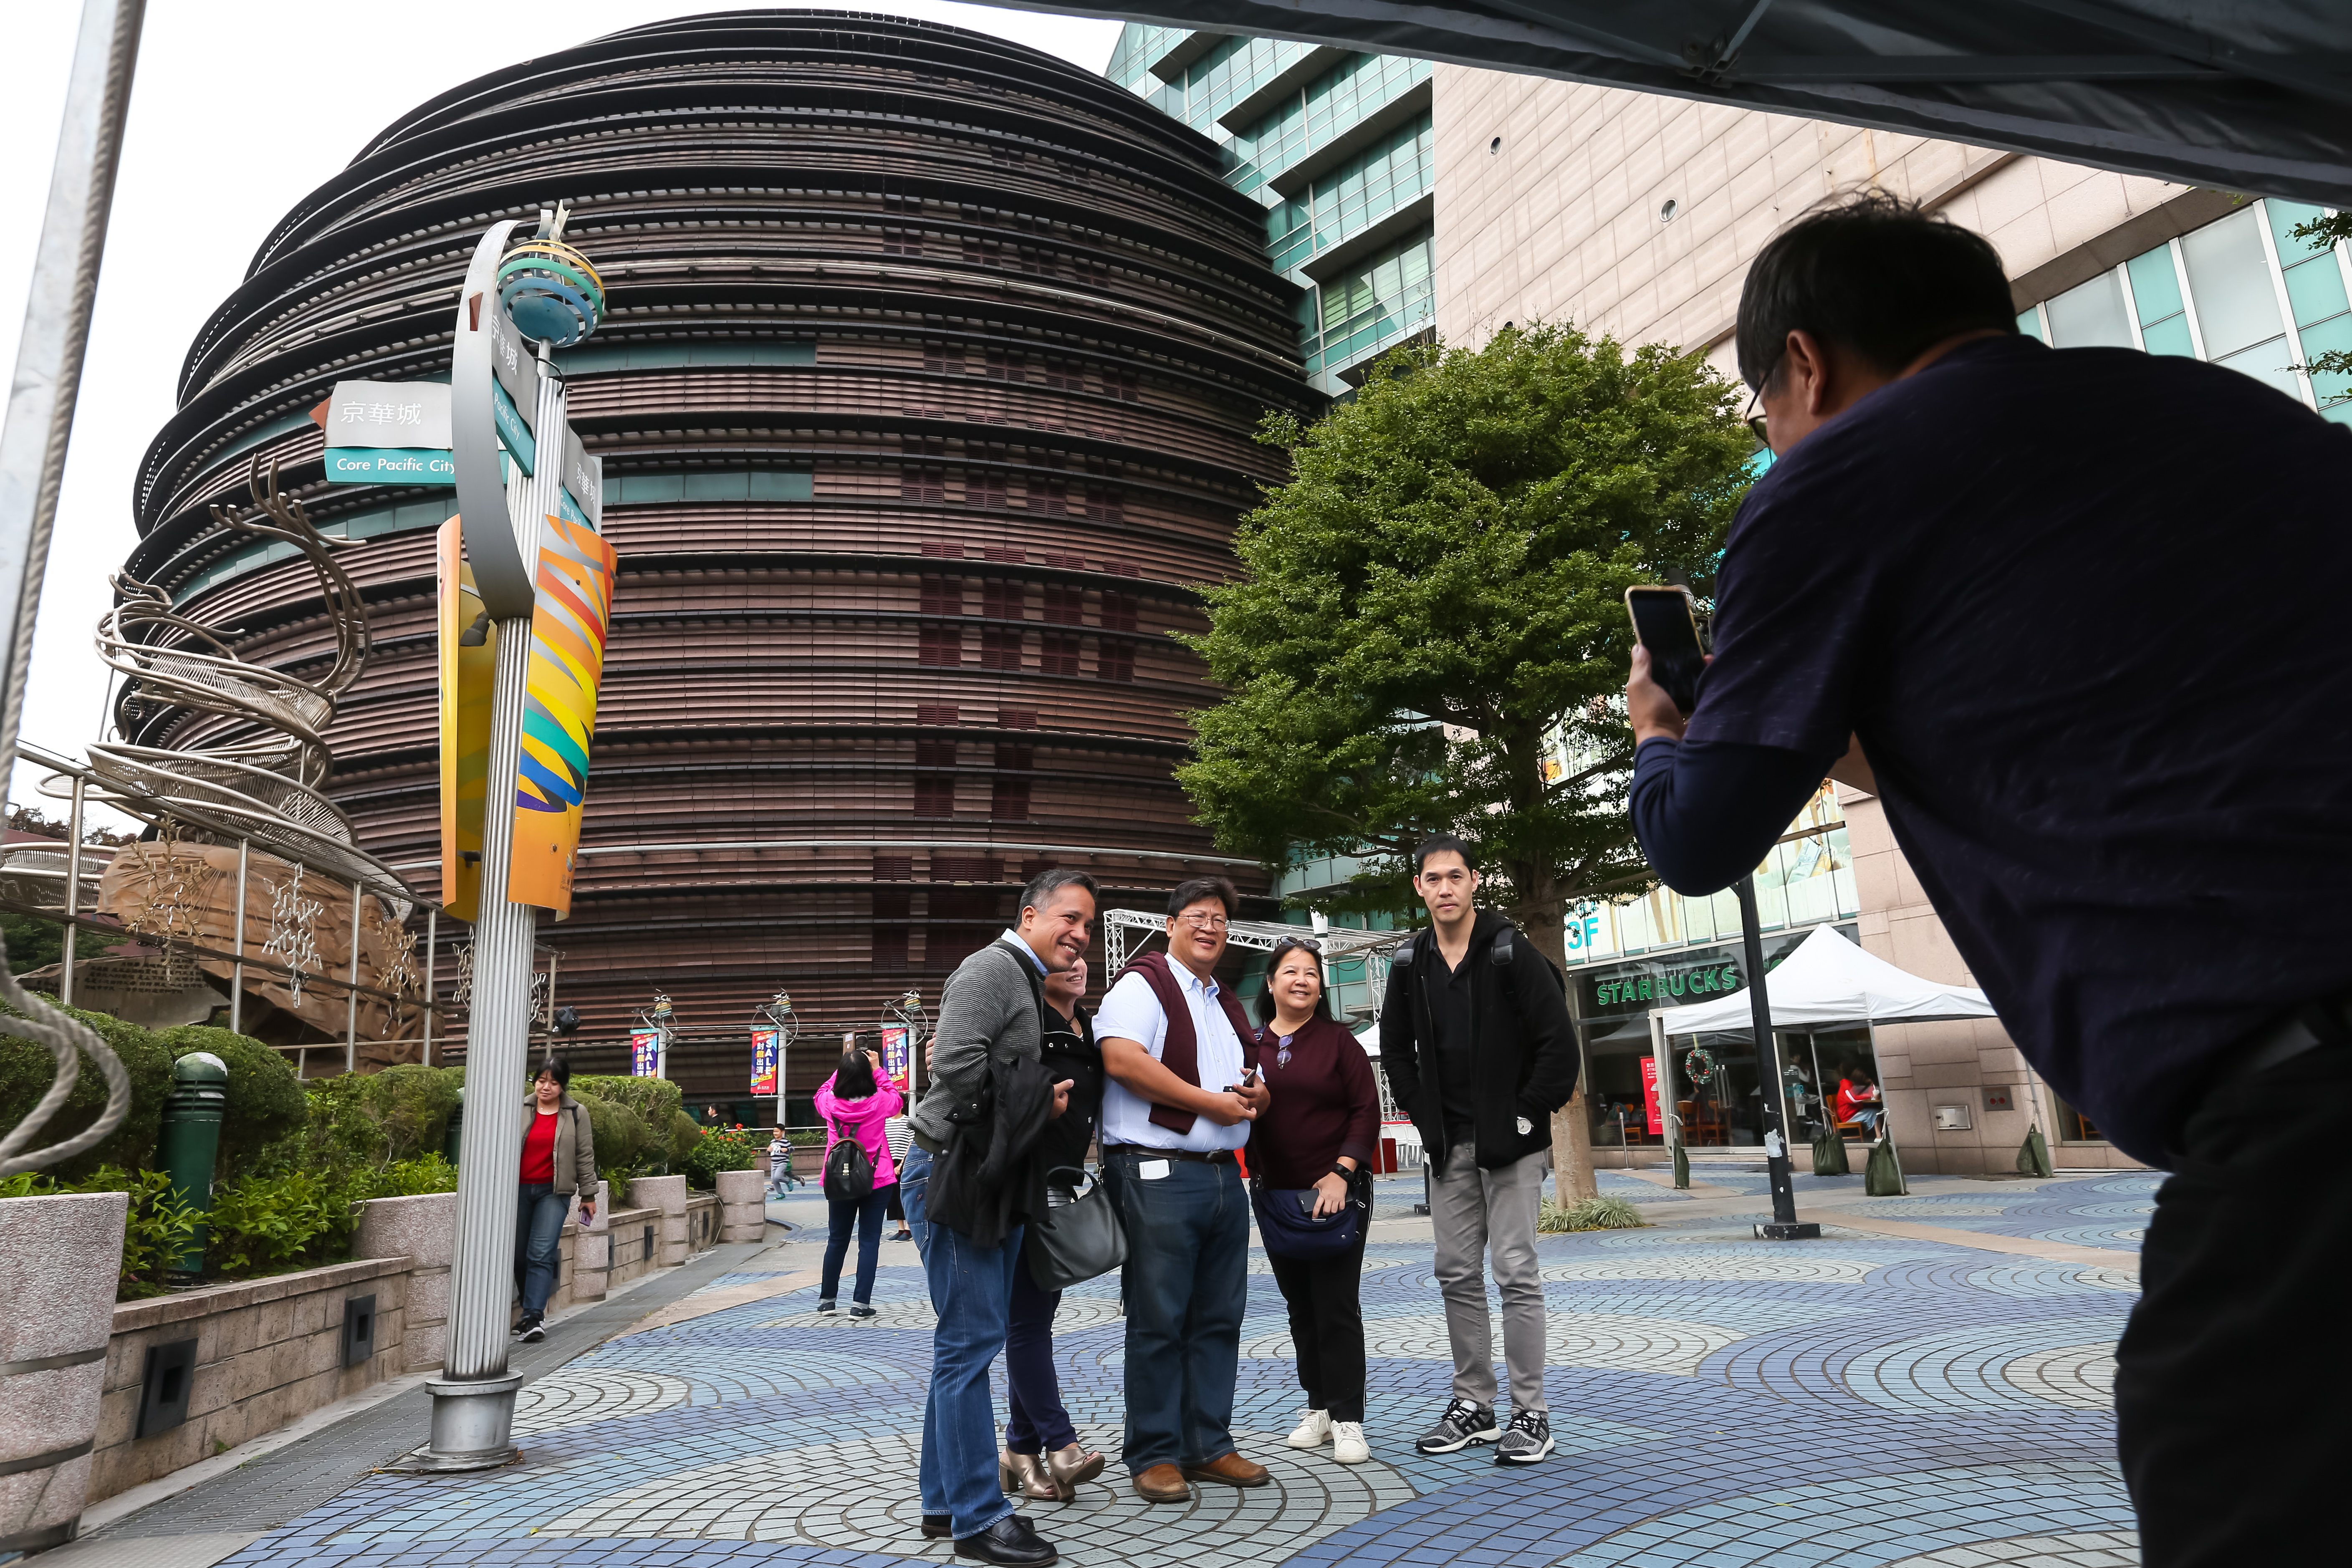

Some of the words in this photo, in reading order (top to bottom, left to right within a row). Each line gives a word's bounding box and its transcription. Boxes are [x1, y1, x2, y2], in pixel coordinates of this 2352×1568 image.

[493, 315, 518, 375] 京華城
[340, 401, 422, 425] 京華城
[494, 392, 509, 425] Pacific
[510, 418, 520, 441] City
[337, 458, 371, 470] Core
[378, 457, 423, 471] Pacific
[429, 460, 455, 474] City
[560, 495, 570, 515] Core
[1568, 917, 1598, 949] 3F
[1597, 967, 1736, 1005] STARBUCKS
[645, 1043, 653, 1078] SALE
[756, 1042, 764, 1074] 封館出清
[887, 1043, 895, 1074] 封館出清
